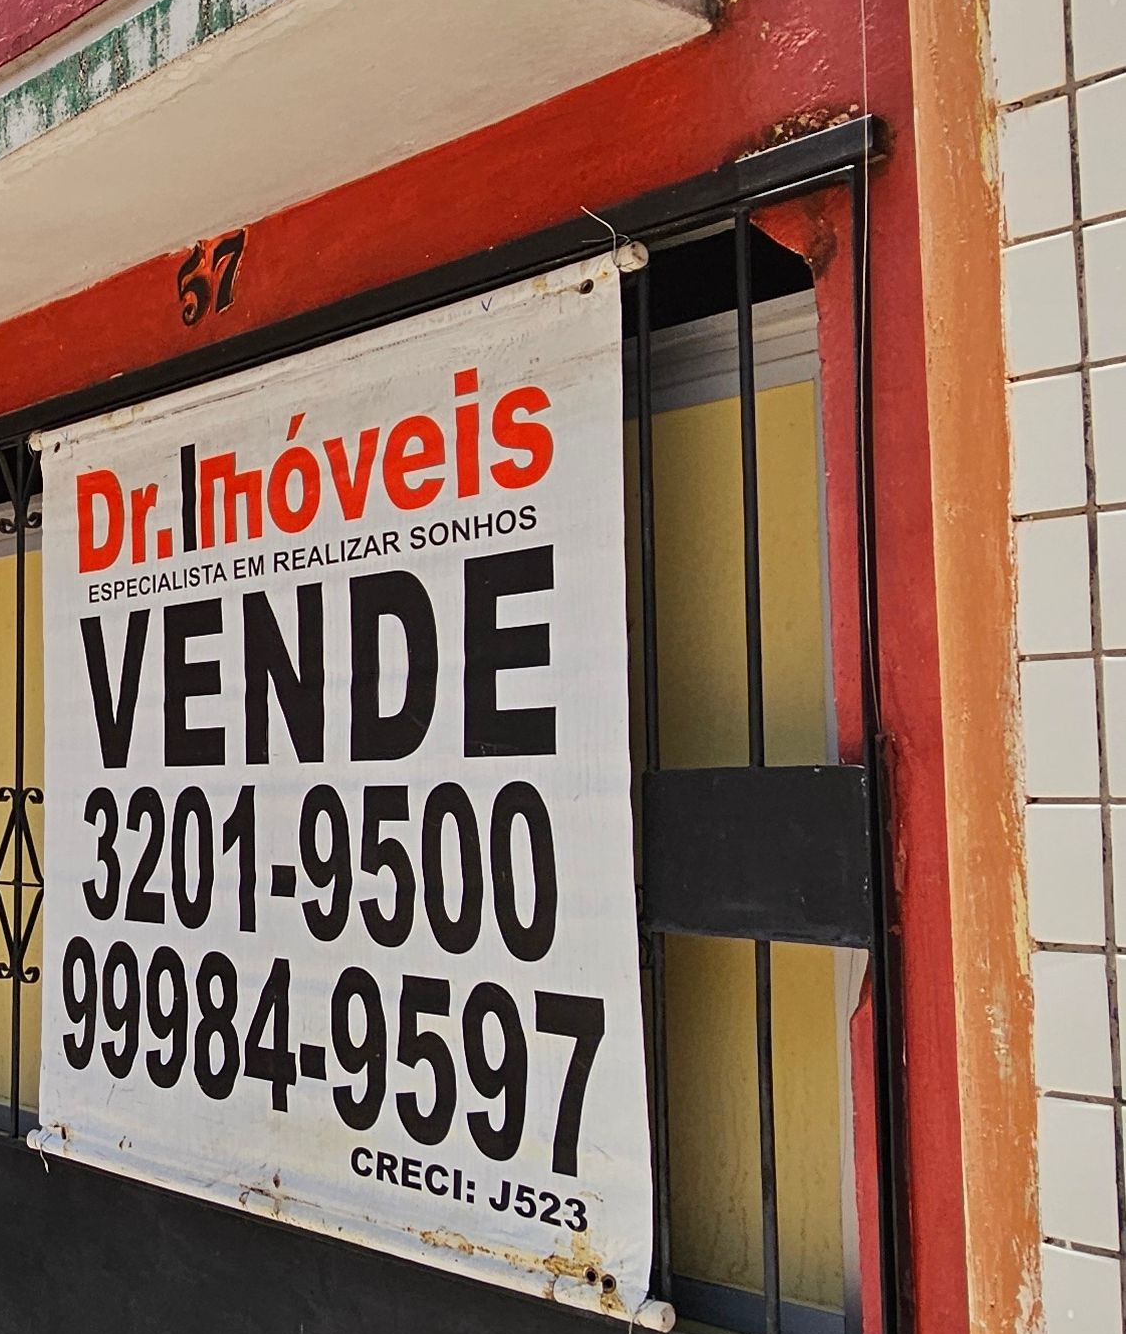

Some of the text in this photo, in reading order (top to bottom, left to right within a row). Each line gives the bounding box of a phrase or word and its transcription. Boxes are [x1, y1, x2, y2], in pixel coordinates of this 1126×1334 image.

[88, 506, 537, 603] ESPECIALISTA EM REALIZAR SONHOS
[80, 546, 556, 768] VENDE
[82, 782, 557, 961] 3201-9500
[62, 937, 605, 1177] 99984-9597
[351, 1147, 588, 1232] CRECI: J523
